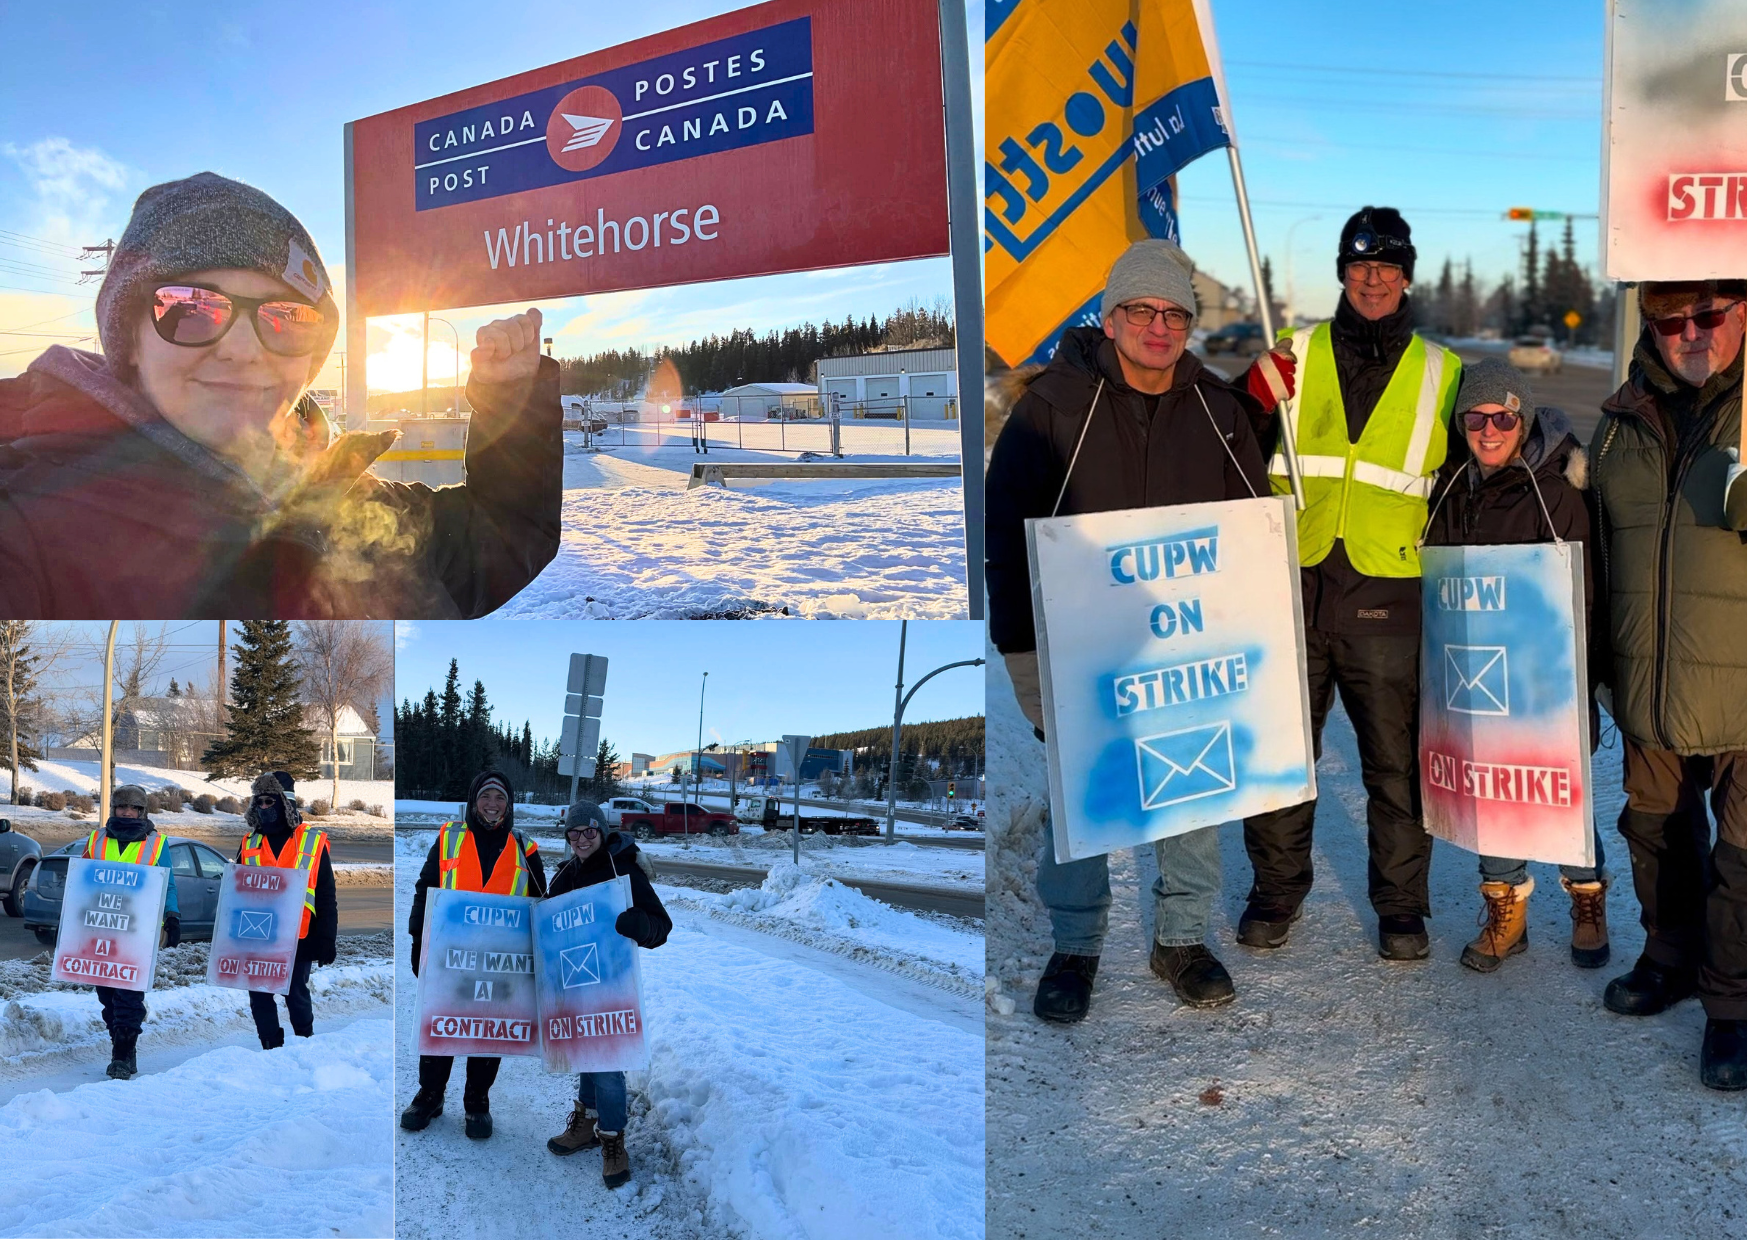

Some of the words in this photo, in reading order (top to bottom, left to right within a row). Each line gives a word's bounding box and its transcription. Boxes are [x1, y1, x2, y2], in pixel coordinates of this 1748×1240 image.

[635, 48, 767, 101] POSTES
[429, 110, 536, 153] CANADA
[635, 100, 788, 151] CANADA
[429, 166, 490, 195] POST
[484, 204, 720, 269] Whitehorse
[1110, 537, 1218, 585] CUPW
[1438, 577, 1503, 610] CUPW
[1150, 599, 1204, 639] ON
[1115, 655, 1247, 715] STRIKE
[1430, 752, 1456, 790] ON
[1464, 761, 1569, 805] STRIKE
[94, 869, 137, 886] CUPW
[243, 873, 280, 890] CUPW
[100, 893, 122, 910] WE
[85, 911, 129, 930] WANT
[466, 906, 520, 928] CUPW
[553, 903, 594, 931] CUPW
[96, 939, 110, 955] A
[448, 950, 476, 970] WE
[62, 957, 138, 982] CONTRACT
[220, 958, 239, 974] ON
[243, 961, 288, 978] STRIKE
[475, 981, 491, 1000] A
[431, 1016, 530, 1041] CONTRACT
[550, 1017, 571, 1039] ON
[576, 1011, 635, 1037] STRIKE
